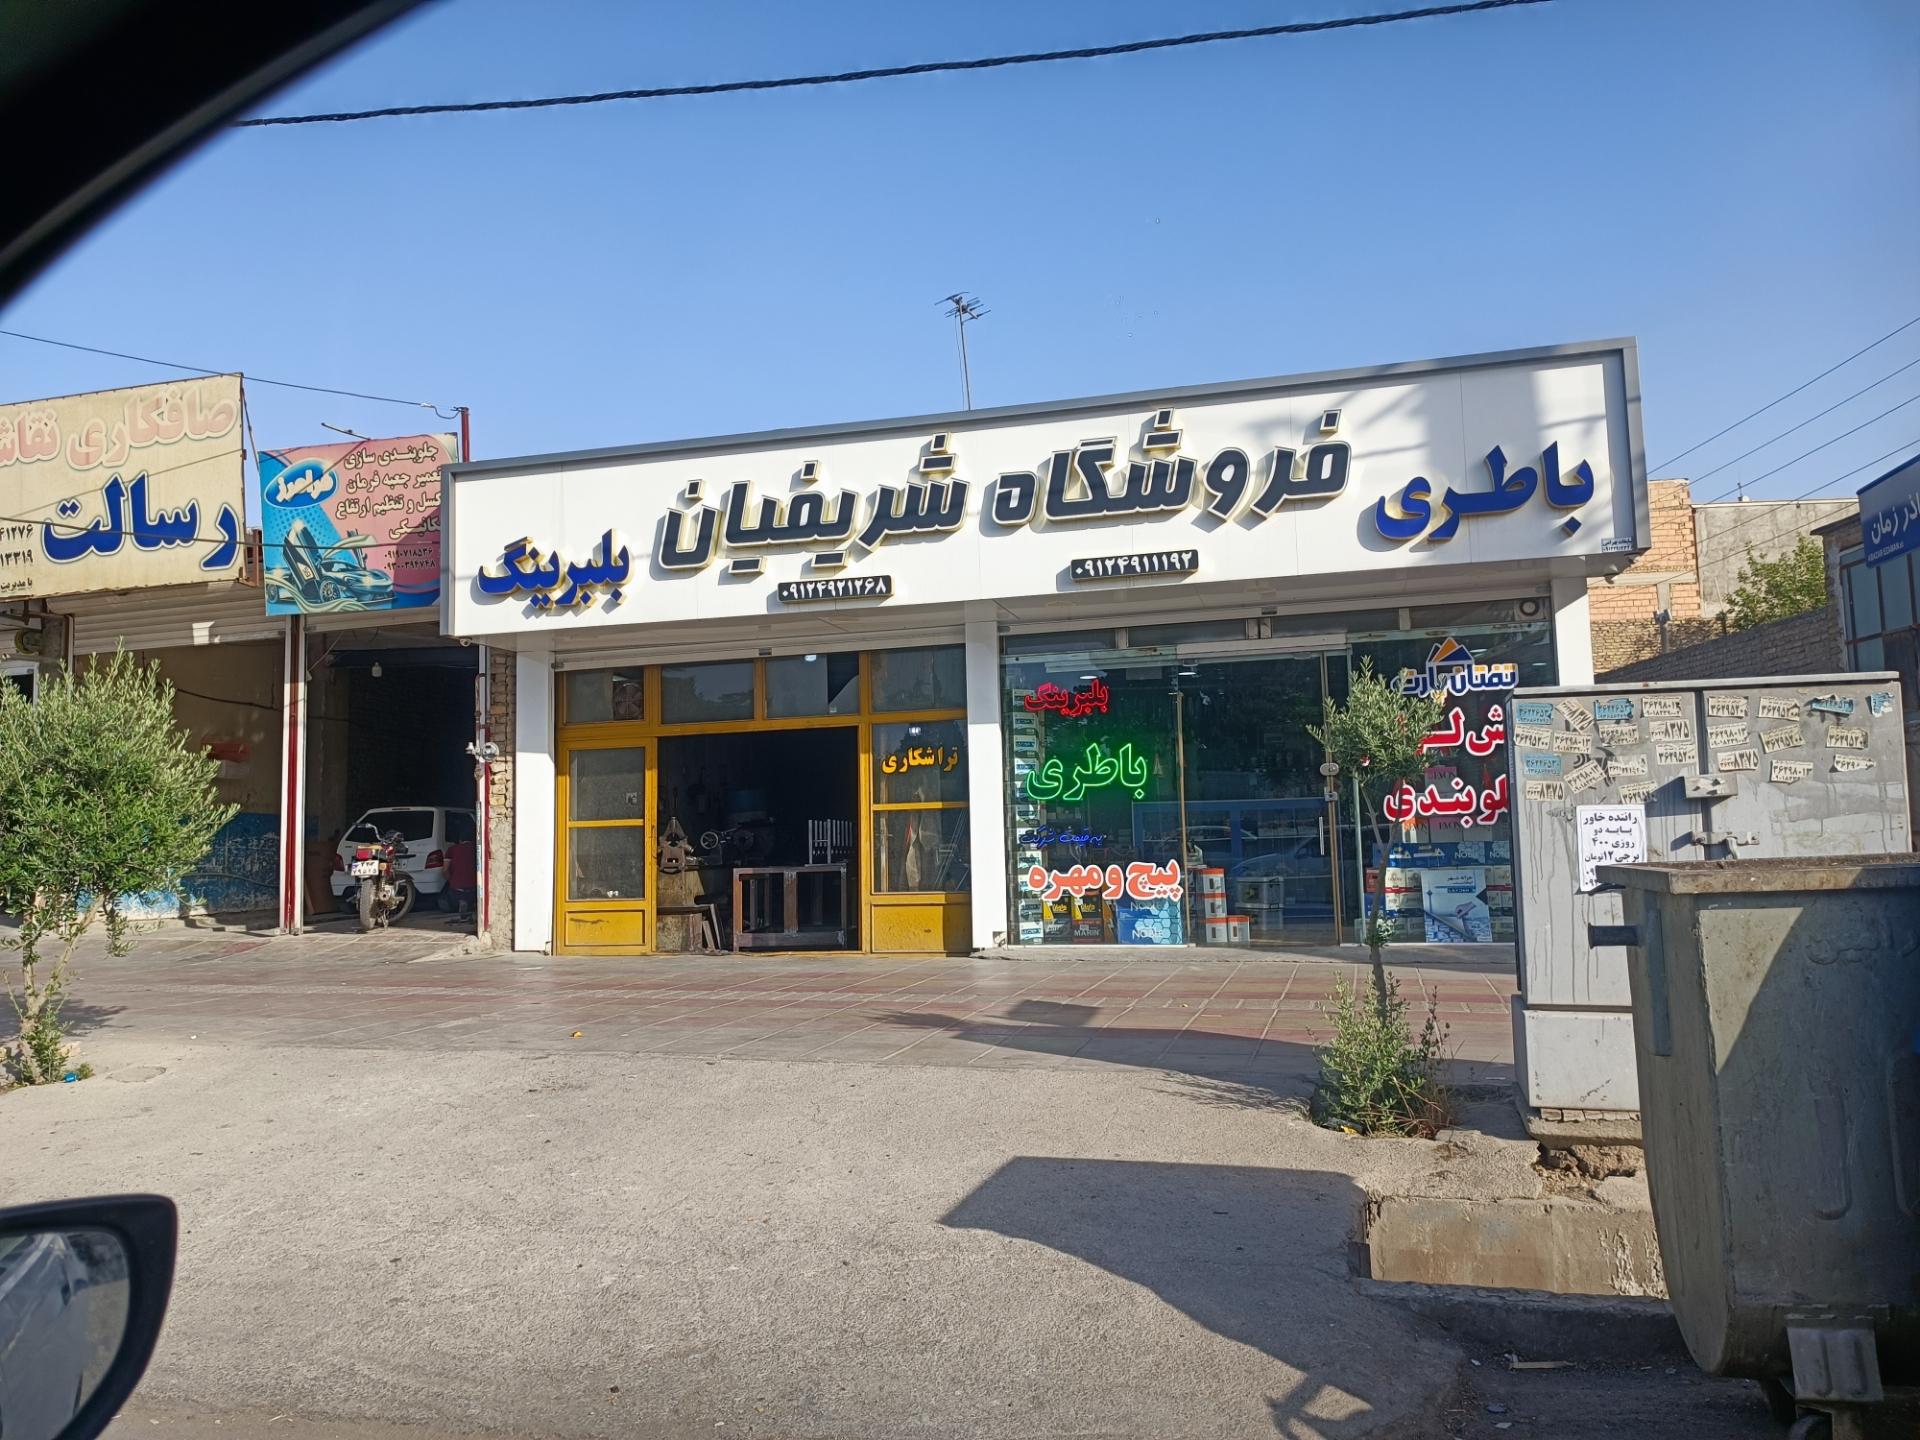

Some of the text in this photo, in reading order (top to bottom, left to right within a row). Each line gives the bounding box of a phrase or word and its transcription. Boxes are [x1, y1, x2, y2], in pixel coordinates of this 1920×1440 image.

[66, 384, 239, 471] صافکاری
[344, 441, 438, 469] جلوبندی سازی
[346, 470, 381, 494] فرمان
[658, 408, 1352, 575] فروشگاه شریفیان
[1375, 440, 1595, 541] باطری
[42, 472, 239, 571] رسالت
[477, 528, 633, 610] بلبرینگ
[781, 577, 887, 600] ۰۹۱۲۴۹۲۱۲۶۸
[1075, 550, 1193, 577] ۰۹۱۲۴۹۱۱۱۹۲
[1024, 679, 1110, 718] بلبرینگ
[1026, 742, 1148, 801] باطری
[1028, 858, 1183, 901] پیچ و مهره
